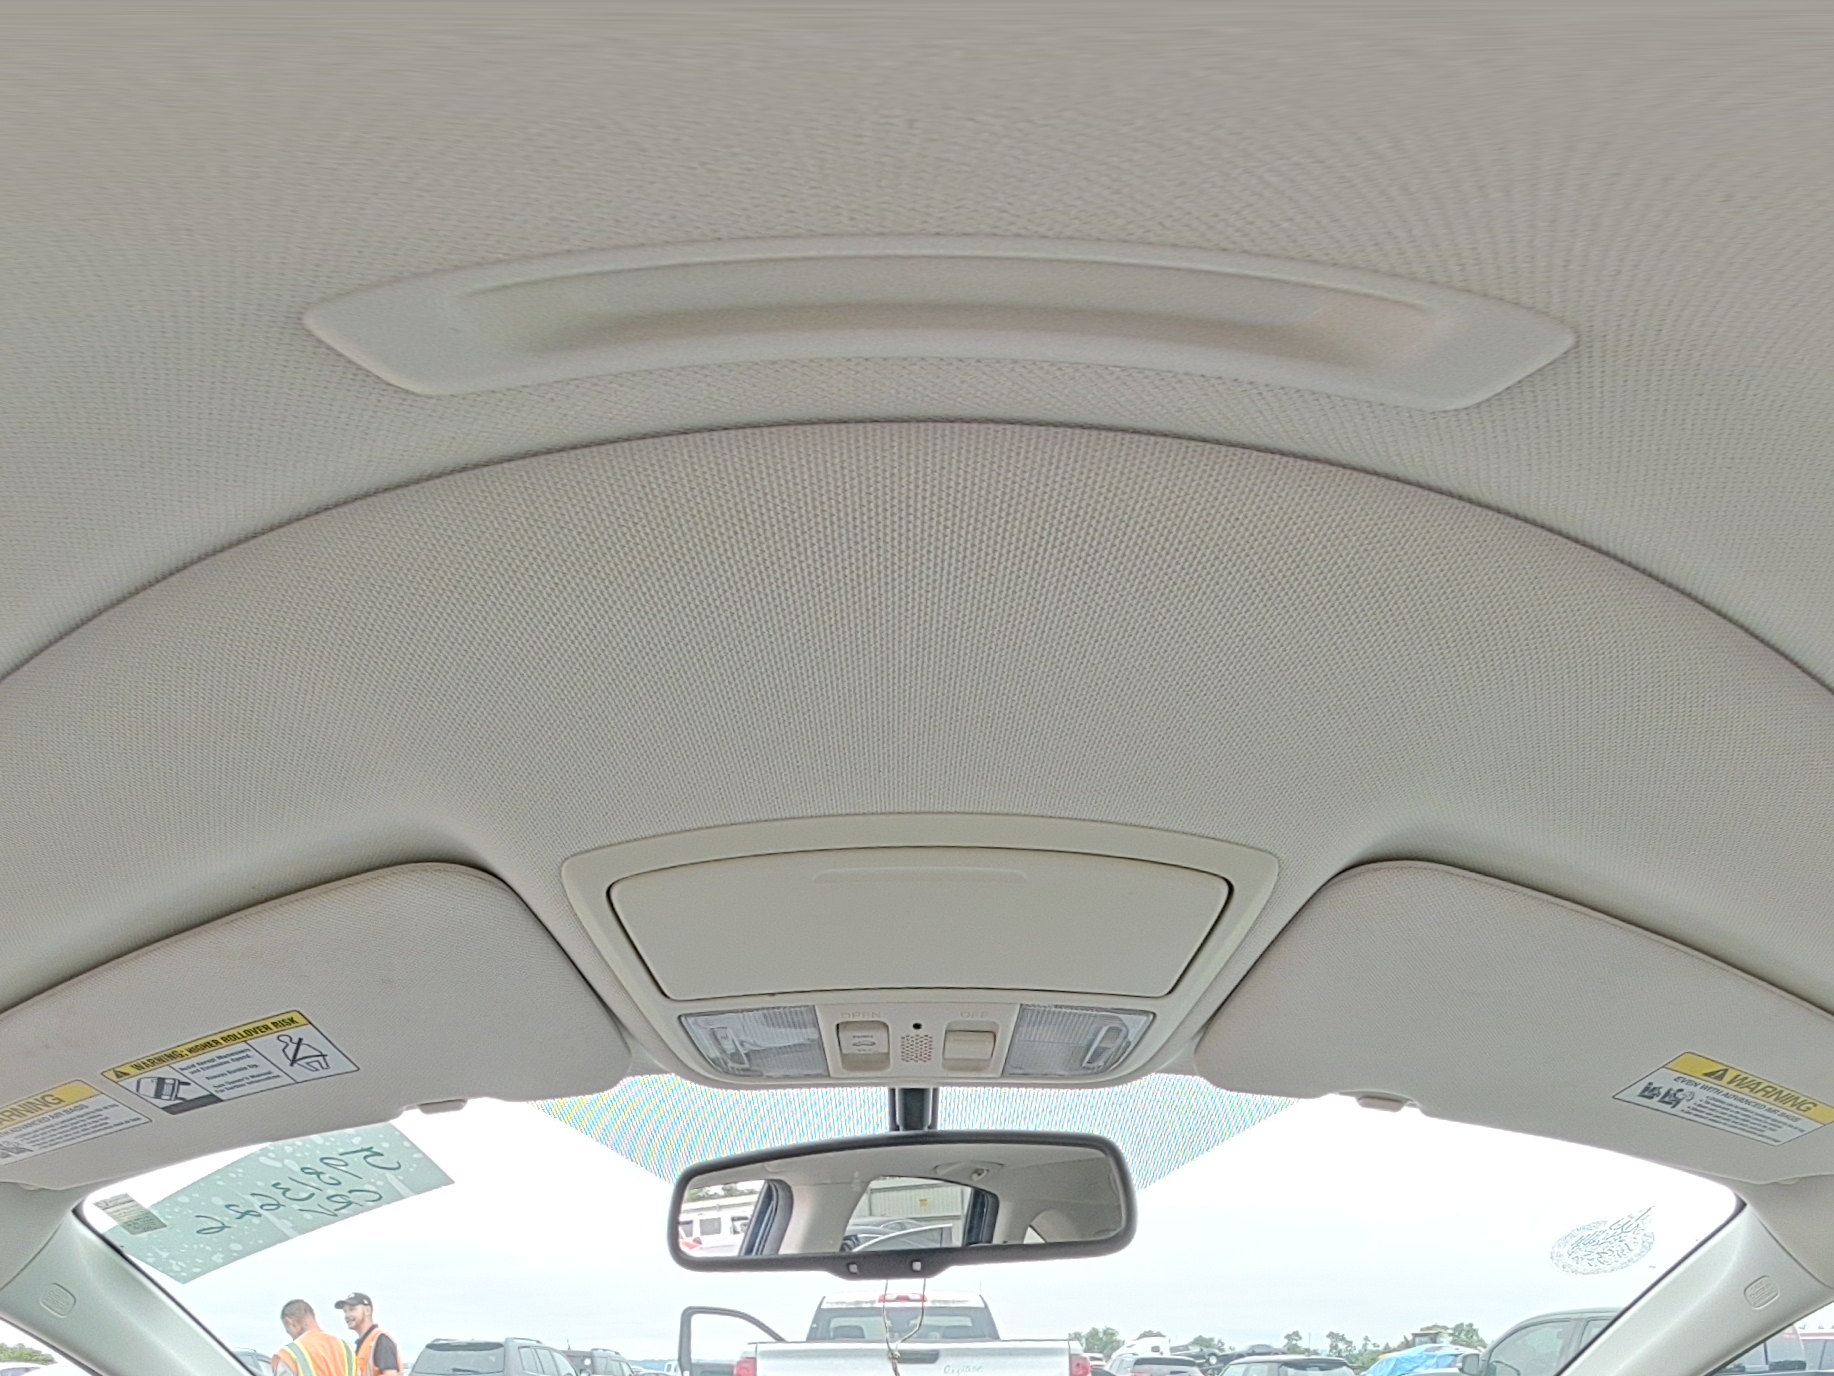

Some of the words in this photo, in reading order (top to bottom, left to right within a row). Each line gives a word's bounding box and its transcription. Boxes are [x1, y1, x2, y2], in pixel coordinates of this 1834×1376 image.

[840, 1011, 881, 1019] OPEN
[187, 1038, 222, 1056] HIGHER
[219, 1024, 272, 1044] ROLLOVER
[273, 1016, 299, 1030] RISK
[1673, 1076, 1699, 1088] EVEN
[1699, 1083, 1723, 1096] WITH
[1722, 1091, 1767, 1110] ADVANCED
[1726, 1074, 1818, 1113] WARNING
